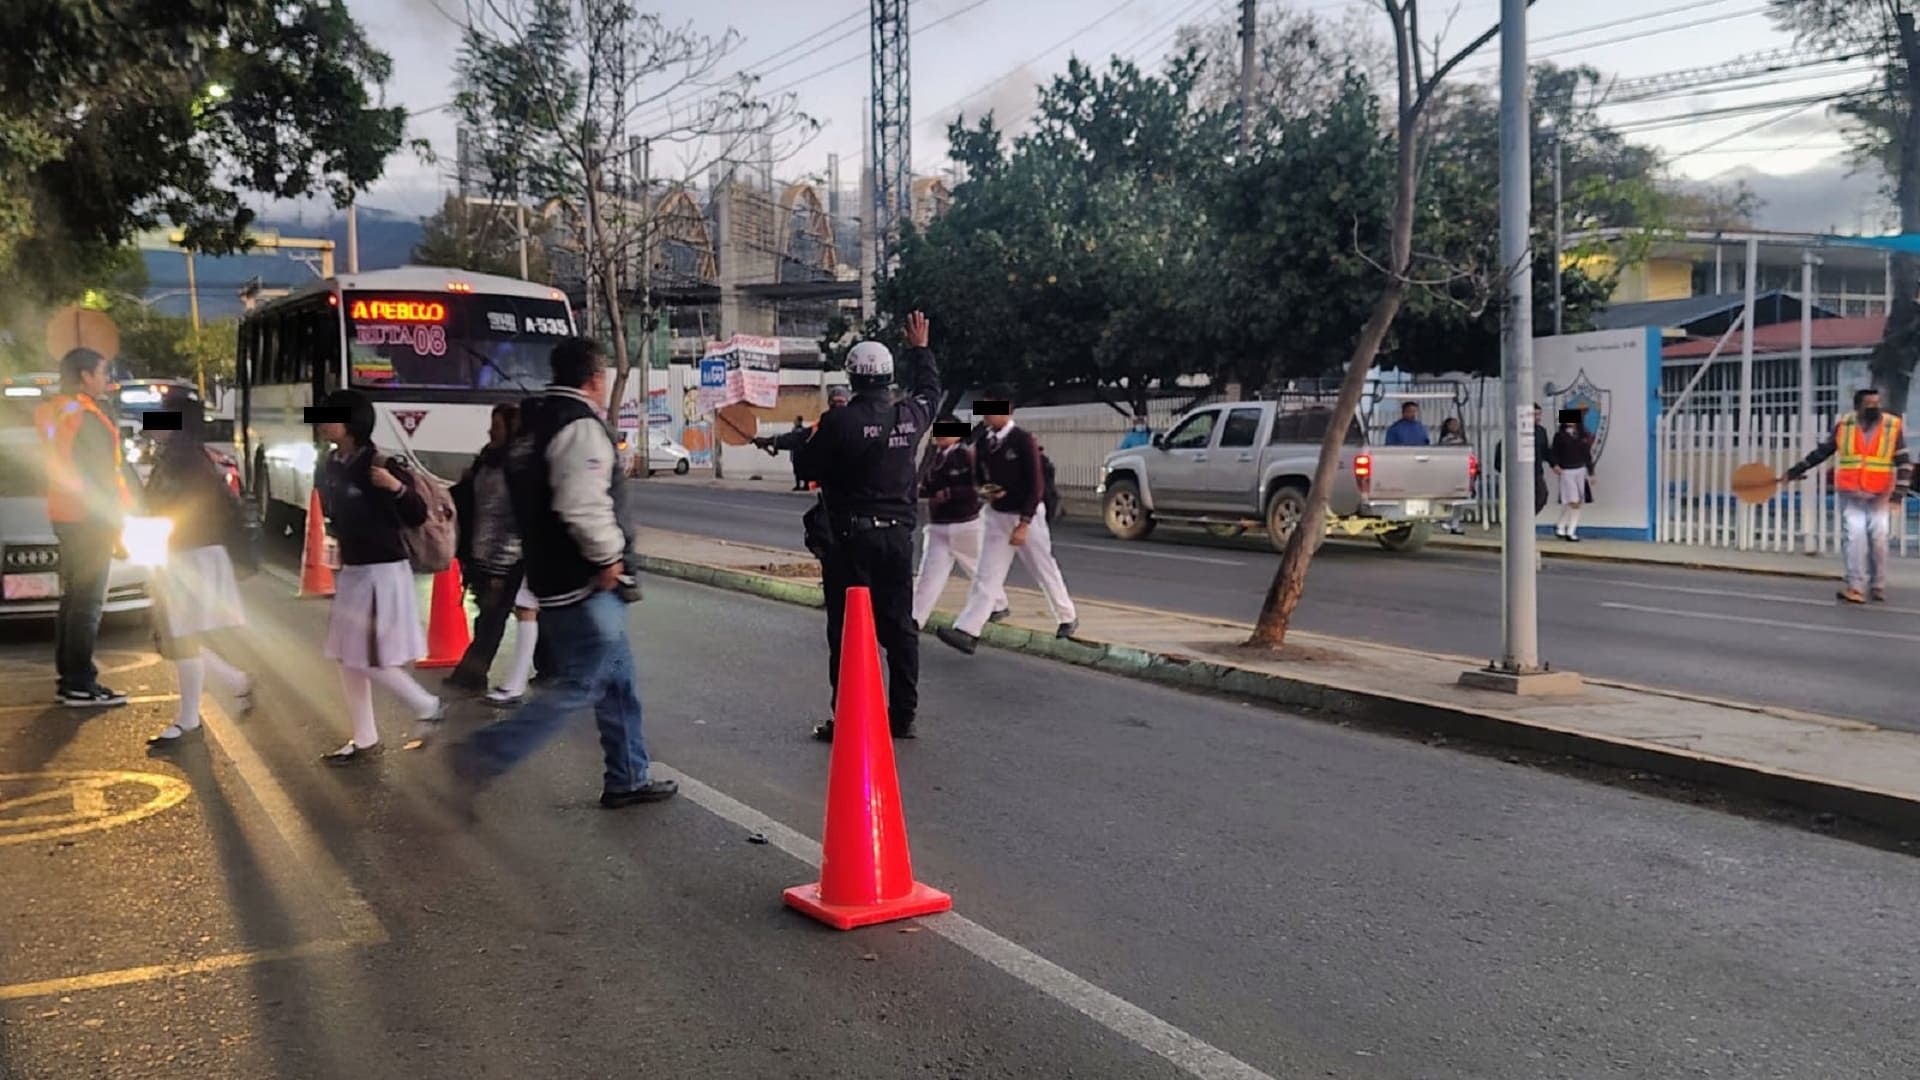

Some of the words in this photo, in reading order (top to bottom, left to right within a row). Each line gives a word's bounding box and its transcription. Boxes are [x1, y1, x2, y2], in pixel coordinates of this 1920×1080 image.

[525, 317, 569, 336] A-535
[355, 324, 414, 344] RUTA
[413, 324, 447, 356] 08
[404, 416, 416, 430] 8
